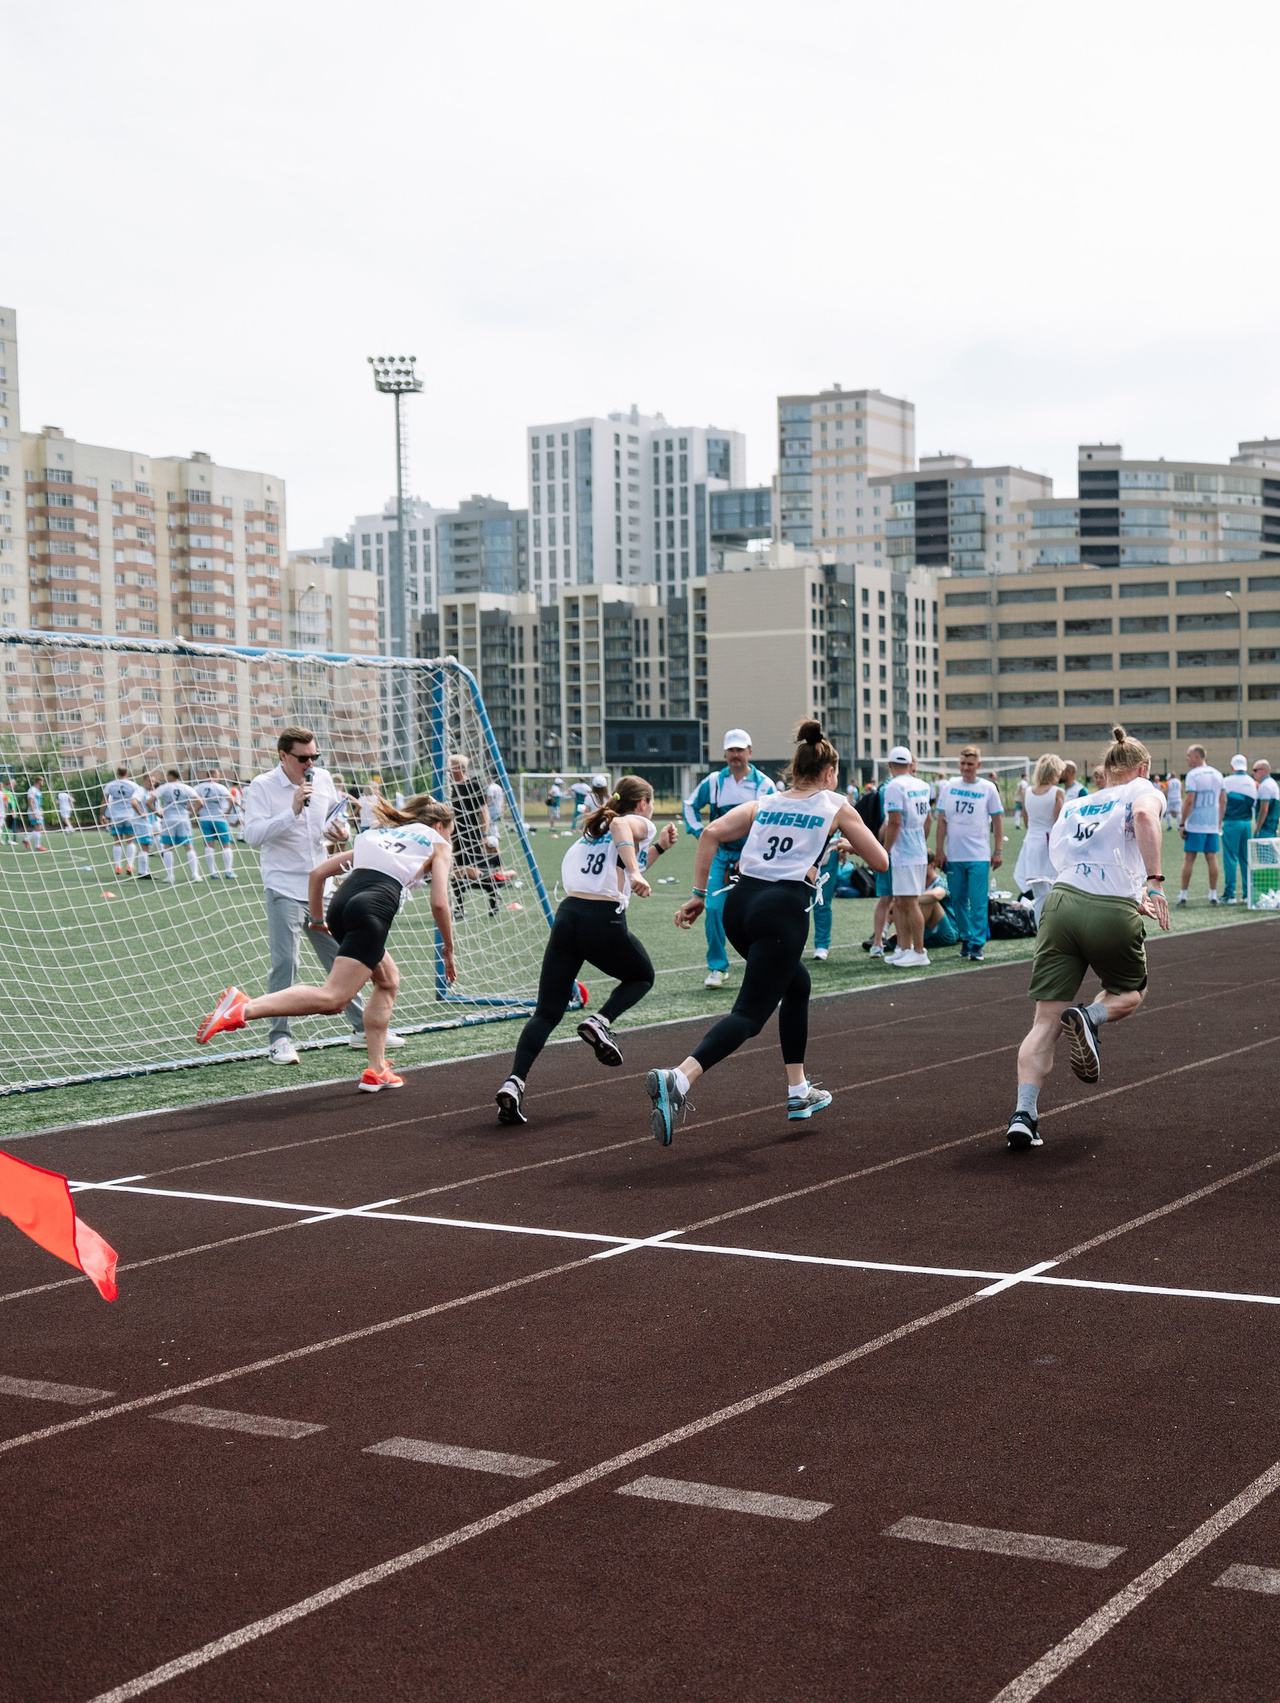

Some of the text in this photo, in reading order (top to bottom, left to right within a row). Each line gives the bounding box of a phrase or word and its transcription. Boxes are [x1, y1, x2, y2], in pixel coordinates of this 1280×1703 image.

[173, 789, 181, 801] 9
[955, 801, 975, 814] 175
[1064, 798, 1120, 819] СИБУ
[755, 810, 826, 829] СИБУР
[1073, 822, 1100, 841] 40
[580, 852, 606, 875] 38
